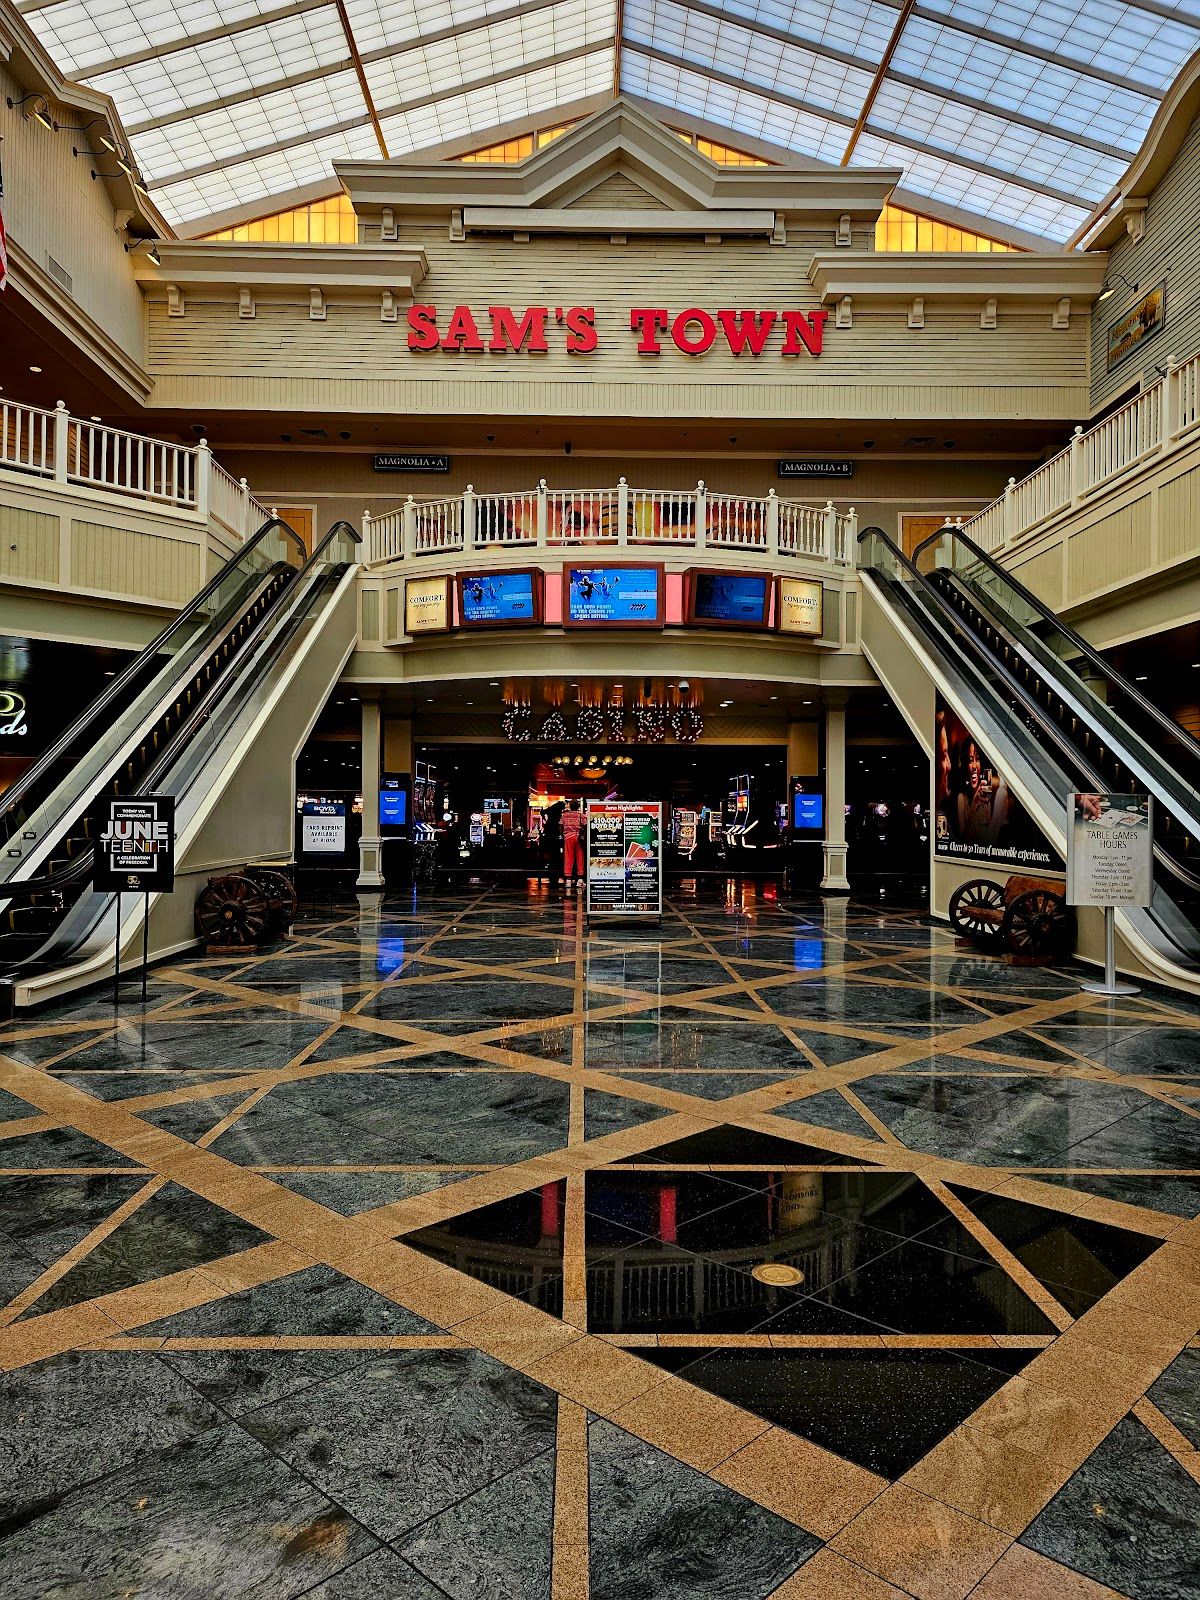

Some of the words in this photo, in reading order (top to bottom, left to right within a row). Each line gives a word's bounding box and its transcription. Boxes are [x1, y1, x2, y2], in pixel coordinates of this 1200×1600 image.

[407, 304, 598, 353] SAM'S
[631, 308, 828, 356] TOWN
[378, 458, 430, 466] MAGNOLIA
[502, 708, 704, 742] CASINO
[100, 821, 168, 839] JUNE
[1086, 830, 1110, 839] TABLE
[1113, 831, 1137, 840] GAMES
[100, 840, 168, 852] TEENTH
[1100, 840, 1126, 848] HOURS
[950, 842, 963, 852] Cheers
[974, 844, 986, 854] Years
[986, 845, 992, 856] of
[991, 847, 1017, 858] memorable
[1018, 849, 1050, 862] experiences.
